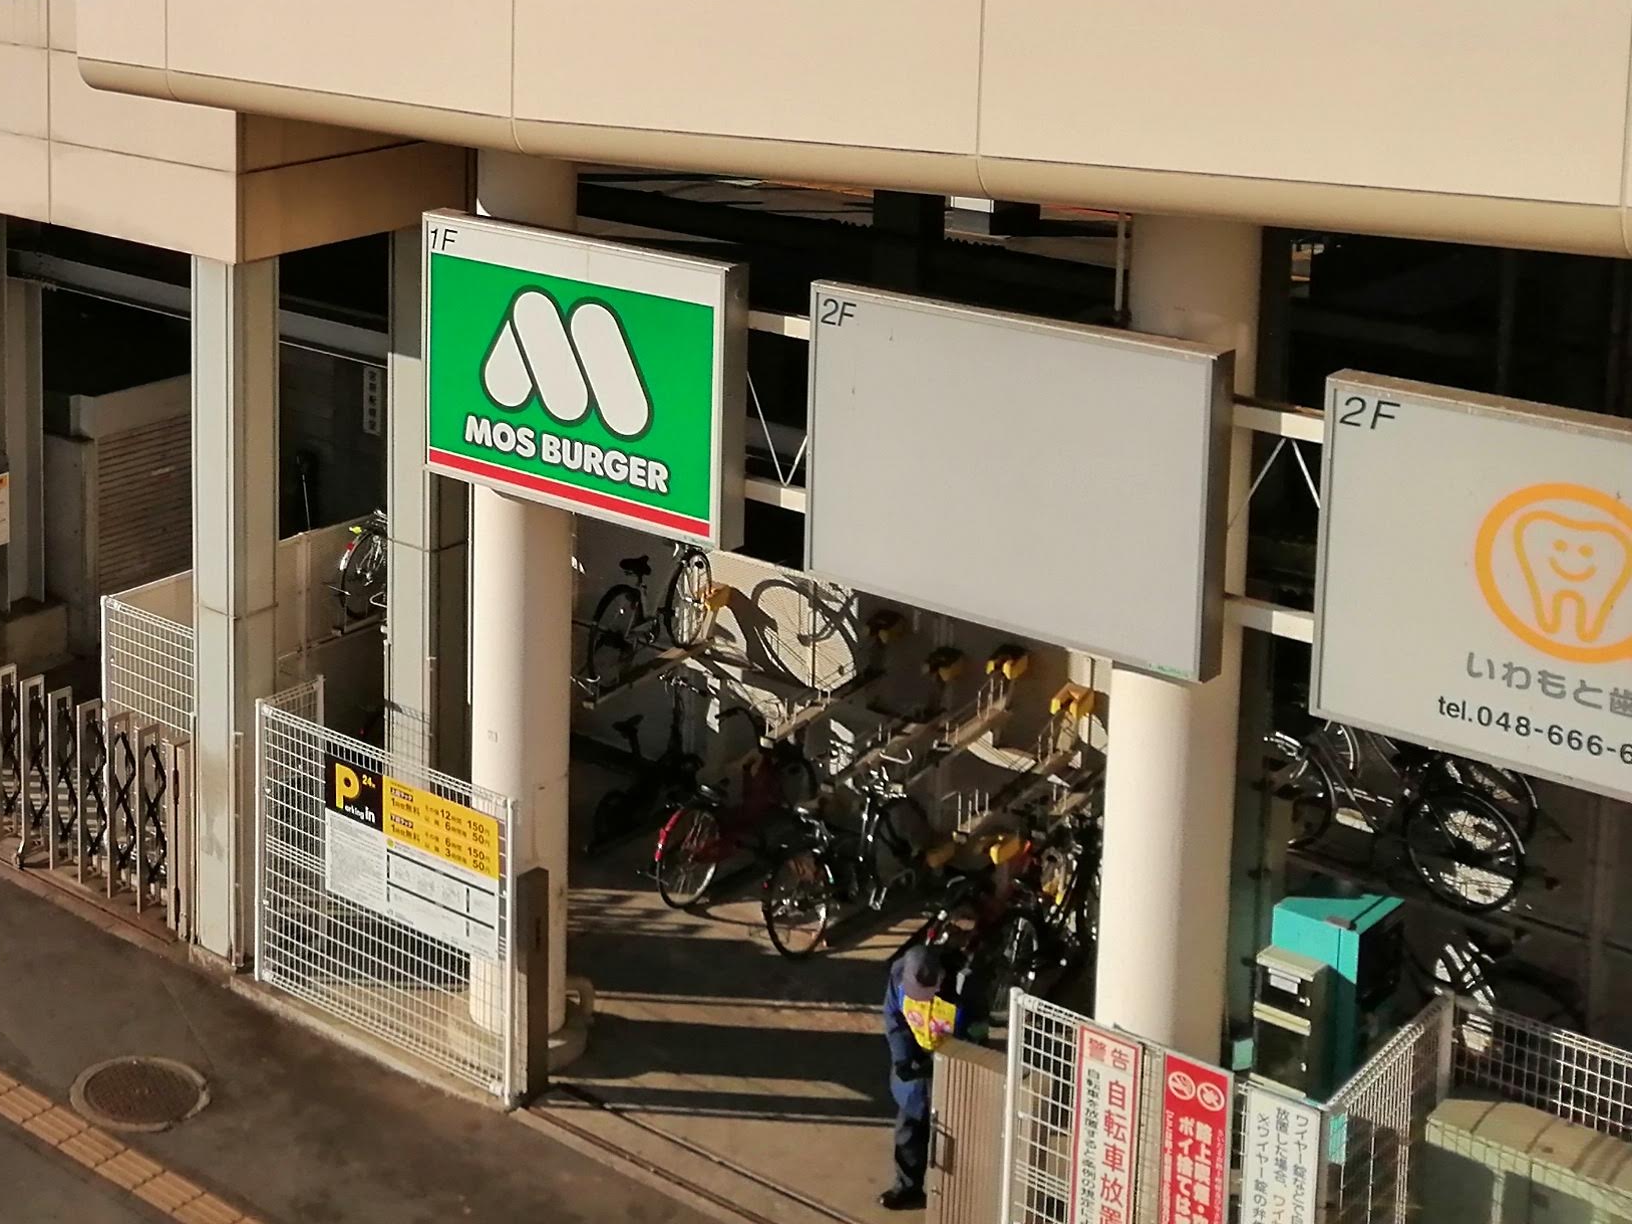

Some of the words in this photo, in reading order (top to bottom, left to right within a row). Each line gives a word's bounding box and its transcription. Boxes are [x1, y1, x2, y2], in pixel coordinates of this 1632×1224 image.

[429, 228, 458, 252] 1F
[820, 298, 857, 327] 2F
[1339, 396, 1401, 430] 2F
[465, 414, 537, 459] MOS
[540, 433, 670, 494] BURGER
[1466, 651, 1632, 718] いわもと歯
[1087, 1037, 1130, 1072] 警告
